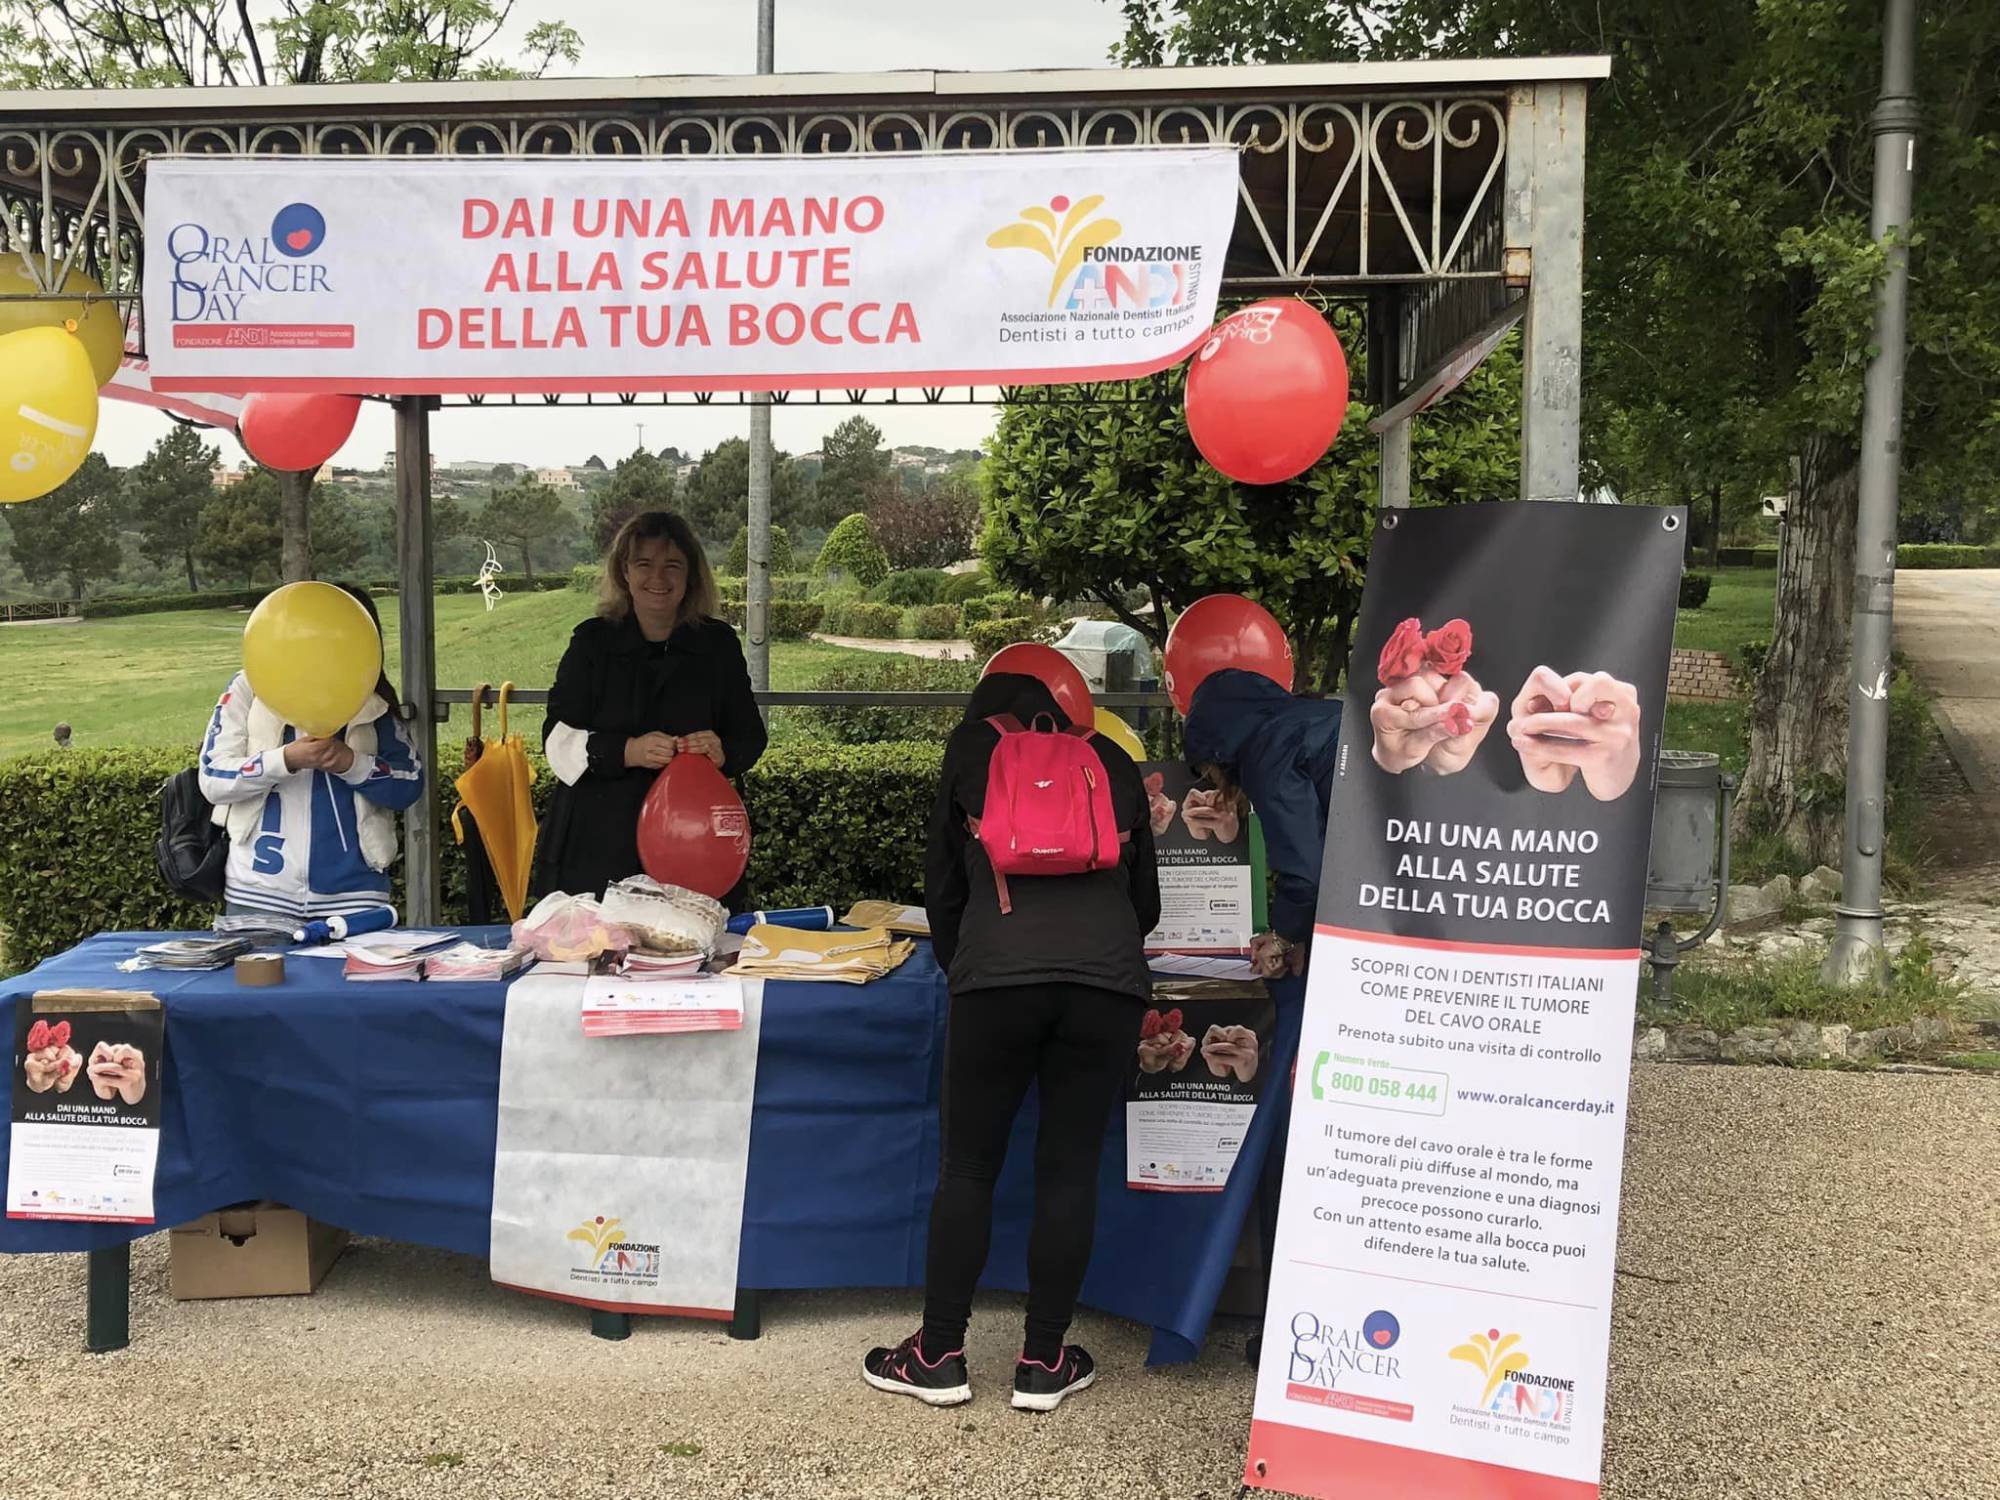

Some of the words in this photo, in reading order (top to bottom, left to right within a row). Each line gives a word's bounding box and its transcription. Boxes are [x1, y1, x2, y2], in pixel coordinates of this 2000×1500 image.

[463, 198, 553, 238] DAI
[573, 198, 690, 238] UNA
[709, 196, 884, 237] MANO
[168, 223, 276, 264] ORAL
[1083, 245, 1202, 262] FONDAZIONE
[175, 251, 334, 292] CANCER
[484, 251, 622, 292] ALLA
[640, 248, 850, 290] SALUTE
[1065, 264, 1184, 310] ANDI
[170, 281, 246, 321] DAY
[1000, 311, 1066, 323] Associazione
[1070, 312, 1120, 321] Nazionale
[1123, 308, 1162, 321] Dentisti
[418, 307, 587, 350] DELLA
[600, 304, 711, 347] TUA
[730, 302, 920, 346] BOCCA
[1000, 328, 1067, 342] Dentisti
[1075, 328, 1085, 341] a
[1093, 327, 1135, 340] tutto
[1142, 315, 1194, 337] campo
[1387, 819, 1431, 844] DAI
[1440, 824, 1502, 850] UNA
[1511, 830, 1599, 853] MANO
[1396, 855, 1467, 882] ALLA
[1475, 861, 1580, 888] SALUTE
[1359, 884, 1446, 914] DELLA
[1453, 893, 1508, 919] TUA
[1516, 898, 1611, 924] BOCCA
[1351, 958, 1409, 977] SCOPRI
[1414, 966, 1449, 981] CON
[1454, 970, 1457, 982] I
[1462, 970, 1532, 988] DENTISTI
[1538, 976, 1603, 992] ITALIANI
[1361, 982, 1408, 1000] COME
[1414, 988, 1500, 1008] PREVENIRE
[1504, 996, 1516, 1009] IL
[1521, 997, 1590, 1014] TUMORE
[1405, 1009, 1435, 1025] DEL
[1440, 1013, 1484, 1029] CAVO
[1488, 1017, 1541, 1034] ORALE
[1338, 1024, 1394, 1043] Prenota
[1399, 1034, 1444, 1048] subito
[1448, 1041, 1474, 1052] una
[1479, 1041, 1515, 1056] visita
[1520, 1044, 1533, 1057] di
[1538, 1048, 1601, 1062] controllo
[1139, 1091, 1160, 1099] ALLA
[1161, 1091, 1190, 1099] SALUTE
[1191, 1091, 1217, 1100] DELLA
[1171, 1082, 1185, 1090] DAI
[1187, 1082, 1204, 1090] UNA
[1205, 1083, 1231, 1091] MANO
[1332, 1072, 1364, 1092] 800
[1368, 1078, 1400, 1098] 058
[1405, 1083, 1436, 1102] 444
[1457, 1088, 1616, 1116] www.oralcancerday.it
[24, 1112, 46, 1121] ALLA
[46, 1113, 76, 1123] SALUTE
[76, 1115, 101, 1124] DELLA
[103, 1116, 119, 1125] TUA
[120, 1116, 148, 1126] BOCCA
[57, 1104, 71, 1112] DAI
[72, 1105, 90, 1113] UNA
[91, 1106, 117, 1114] MANO
[1325, 1124, 1333, 1137] Il
[1338, 1128, 1390, 1146] tumore
[1394, 1135, 1416, 1149] del
[1420, 1141, 1453, 1154] cavo
[1457, 1145, 1493, 1159] orale
[1497, 1147, 1505, 1160] è
[1510, 1150, 1529, 1163] tra
[1534, 1150, 1546, 1165] le
[1550, 1153, 1592, 1170] forme
[1335, 1148, 1396, 1168] tumorali
[1400, 1157, 1423, 1172] più
[1427, 1160, 1476, 1178] diffuse
[1480, 1167, 1492, 1180] al
[1497, 1172, 1552, 1189] mondo,
[1557, 1179, 1578, 1190] ma
[1361, 1196, 1418, 1213] precoce
[1422, 1205, 1483, 1222] possono
[1487, 1214, 1542, 1230] curarlo.
[1402, 1181, 1491, 1201] prevenzione
[1496, 1193, 1504, 1203] e
[1508, 1195, 1535, 1207] una
[1540, 1196, 1600, 1215] diagnosi
[609, 1242, 660, 1253] FONDAZIONE
[1314, 1207, 1341, 1222] Con
[1346, 1215, 1364, 1226] un
[1369, 1218, 1421, 1235] attento
[1425, 1227, 1472, 1242] esame
[1476, 1231, 1501, 1246] alla
[1506, 1234, 1548, 1252] bocca
[1553, 1244, 1585, 1258] puoi
[1364, 1236, 1434, 1258] difendere
[1438, 1246, 1450, 1260] la
[1455, 1250, 1477, 1264] tua
[1482, 1255, 1529, 1272] salute.
[1291, 1312, 1363, 1351] ORAL
[1288, 1352, 1342, 1388] DAY
[1294, 1333, 1401, 1379] CANCER
[1504, 1369, 1575, 1392] FONDAZIONE
[1491, 1382, 1563, 1422] ANDI
[1563, 1393, 1574, 1424] ONLUS
[1449, 1414, 1489, 1430] Dentisti
[1494, 1424, 1500, 1432] a
[1504, 1425, 1530, 1438] tutto
[1534, 1431, 1570, 1446] campo
